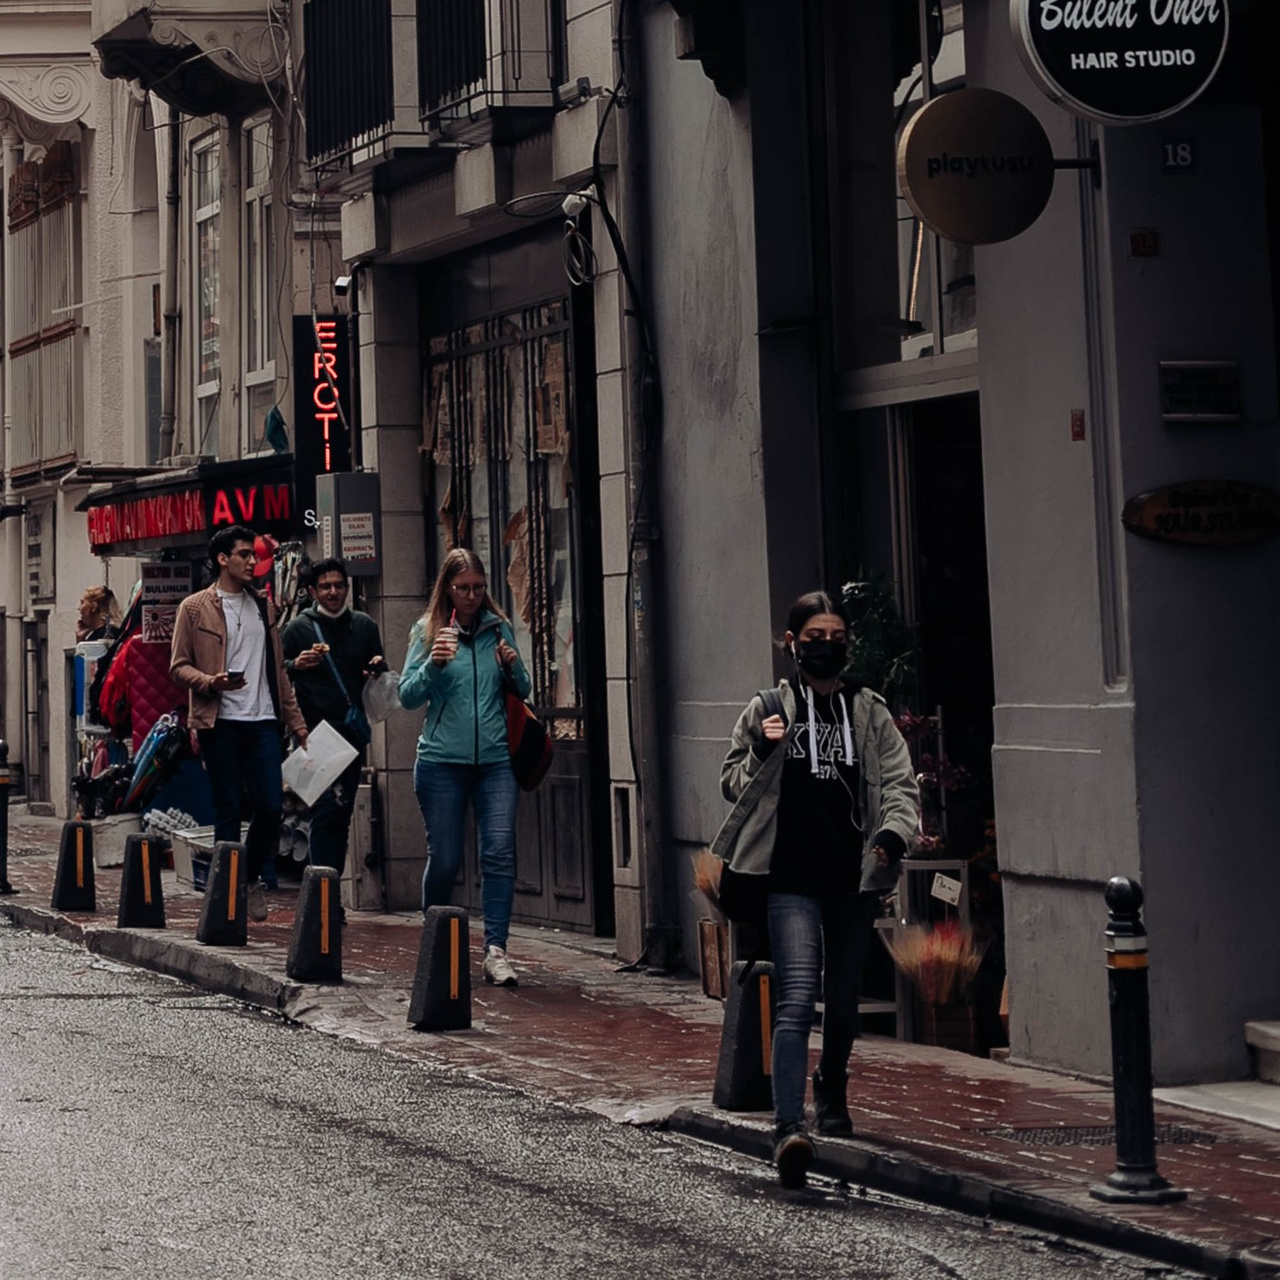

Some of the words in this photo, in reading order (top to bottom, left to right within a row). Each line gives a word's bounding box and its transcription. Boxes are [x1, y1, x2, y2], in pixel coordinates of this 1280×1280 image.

[1070, 51, 1120, 70] HAIR
[1124, 48, 1196, 68] STUDIO
[1163, 143, 1192, 167] 18
[212, 484, 291, 526] AVM
